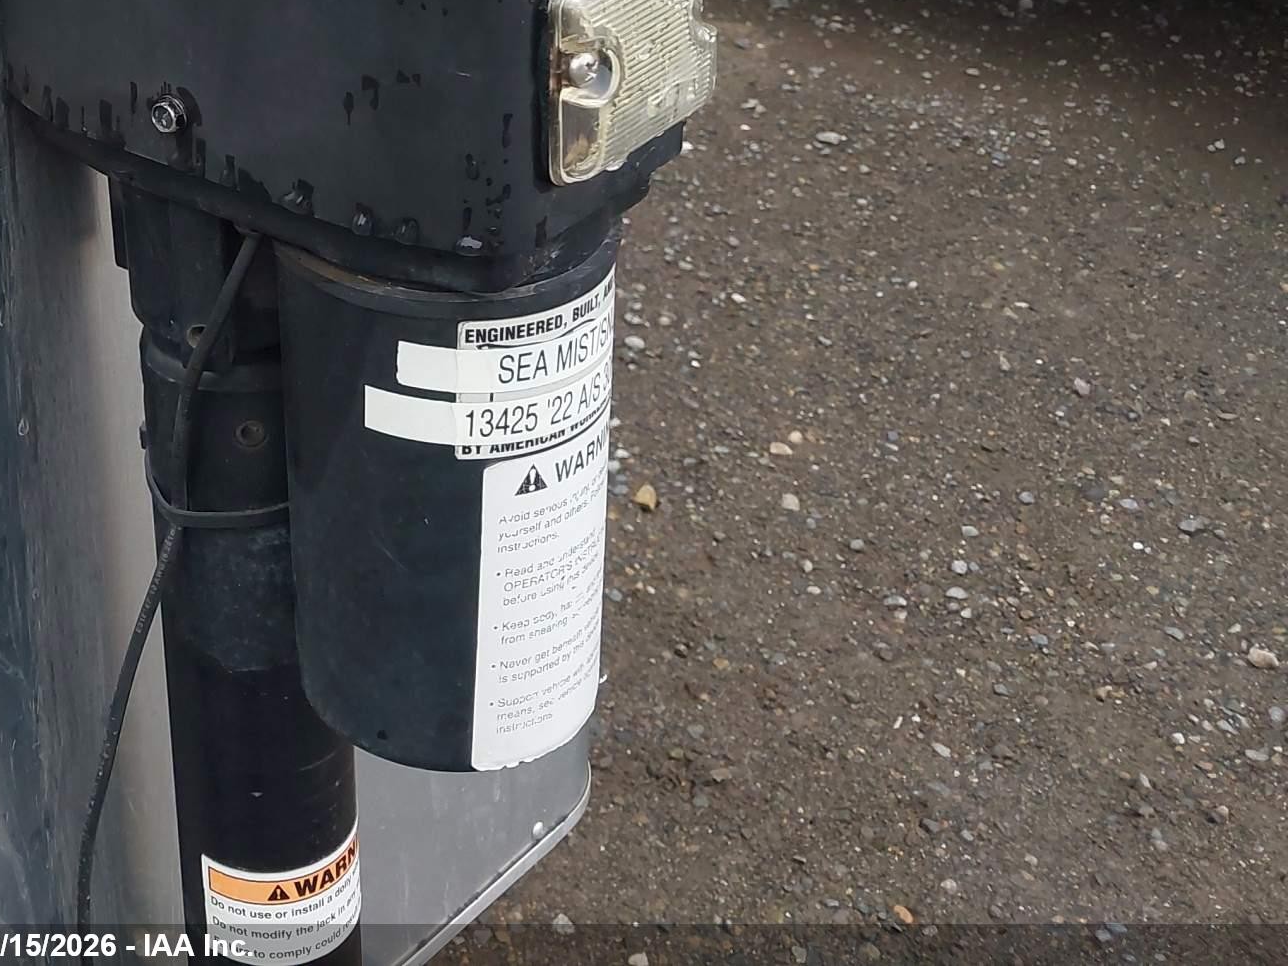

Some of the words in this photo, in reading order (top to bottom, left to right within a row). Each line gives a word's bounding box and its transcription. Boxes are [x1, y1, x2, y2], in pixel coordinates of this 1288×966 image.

[464, 313, 568, 344] ENGINEERED,
[572, 292, 601, 322] BUILT,
[498, 349, 548, 384] SEA
[466, 402, 538, 437] 13425
[544, 514, 562, 530] and
[499, 655, 533, 670] Never
[210, 895, 225, 910] Do
[228, 905, 247, 917] not
[249, 910, 272, 920] use
[275, 910, 288, 919] or
[291, 897, 325, 918] install
[212, 915, 226, 930] Do
[229, 925, 248, 937] not
[251, 929, 293, 940] modify
[295, 925, 314, 937] the
[315, 911, 337, 932] jack
[254, 949, 265, 959] to
[269, 945, 312, 960] comply
[315, 928, 341, 950] could
